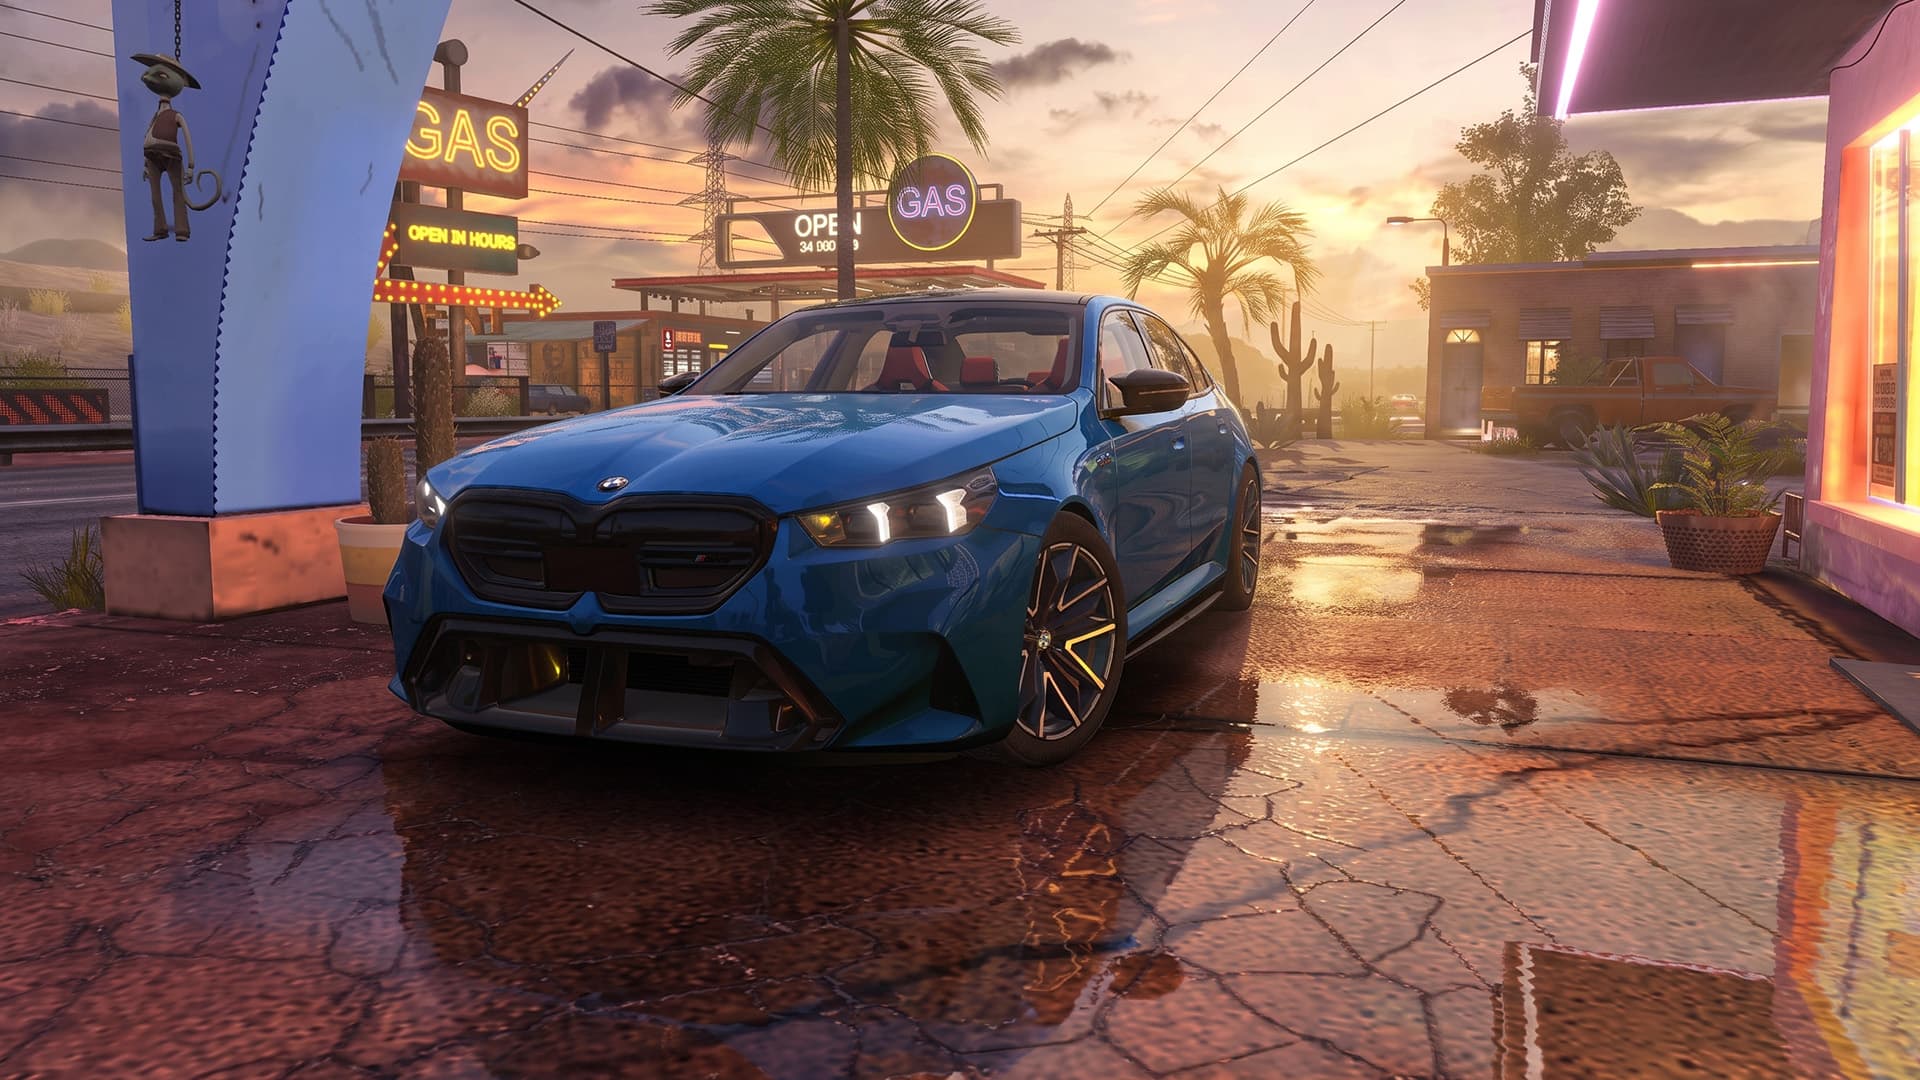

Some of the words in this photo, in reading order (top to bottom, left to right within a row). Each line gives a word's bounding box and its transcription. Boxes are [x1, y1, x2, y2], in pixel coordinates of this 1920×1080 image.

[405, 101, 521, 173] GAS
[897, 184, 967, 218] GAS
[408, 224, 448, 244] OPEN
[451, 229, 467, 246] IN
[469, 231, 517, 251] HOURS
